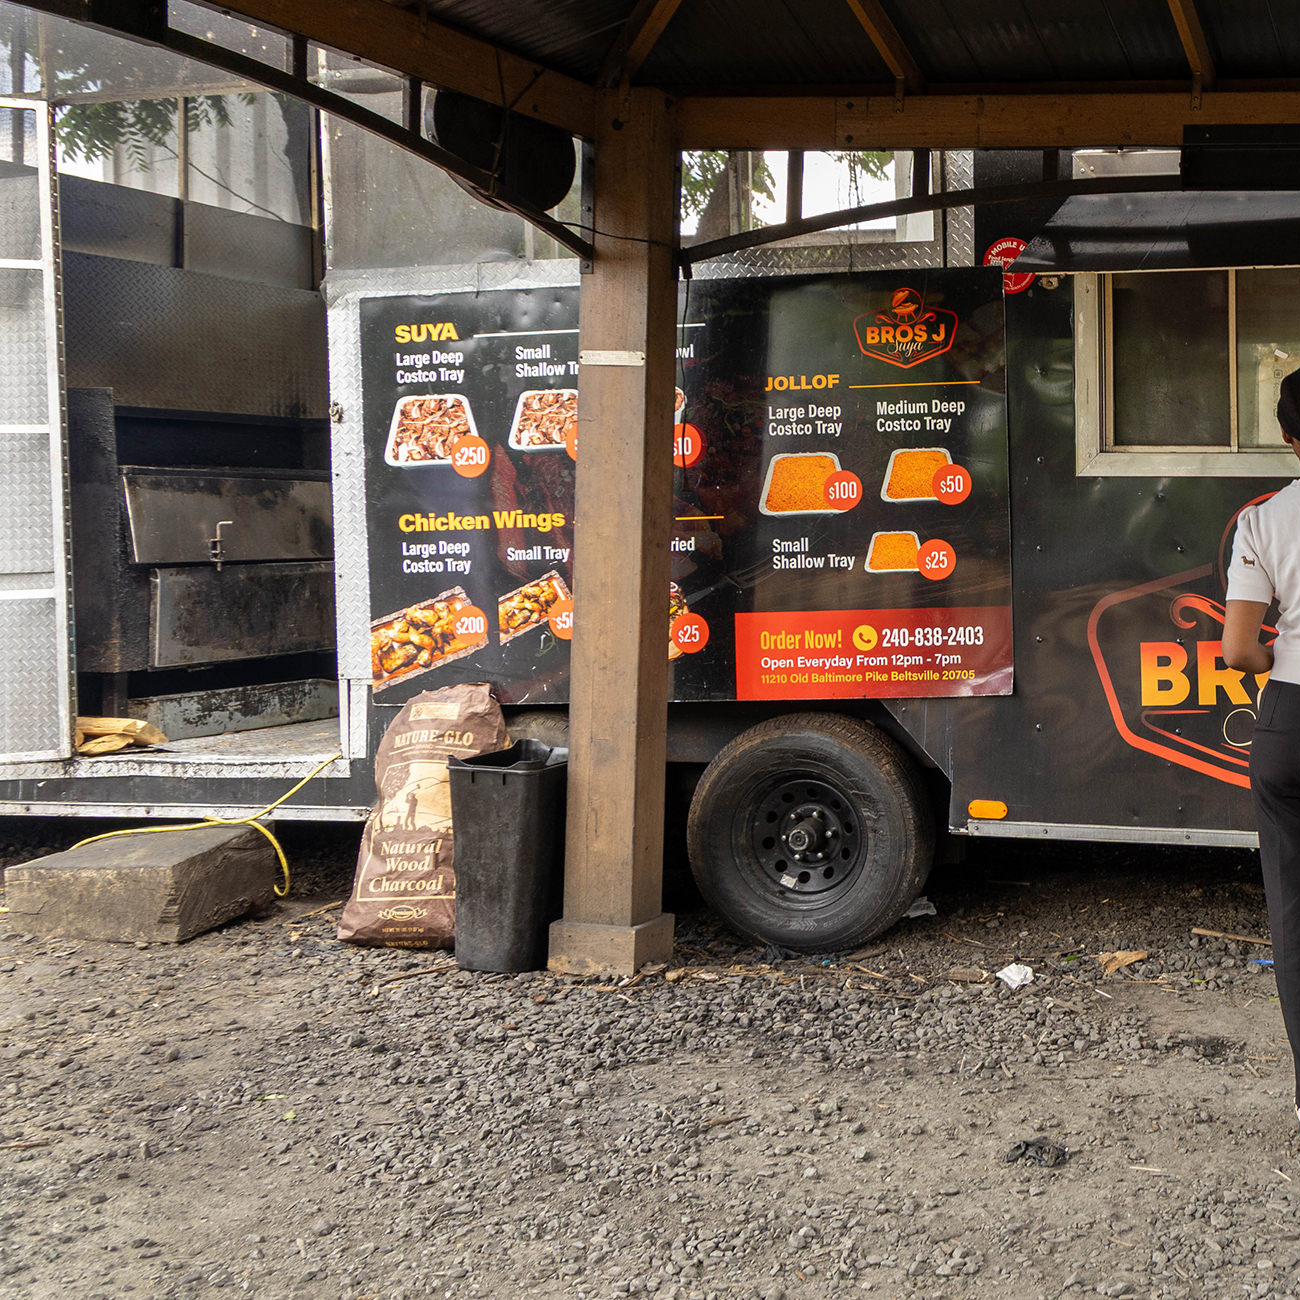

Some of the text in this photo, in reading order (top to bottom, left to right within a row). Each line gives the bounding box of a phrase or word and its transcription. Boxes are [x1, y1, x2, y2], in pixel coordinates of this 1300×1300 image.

[991, 241, 1017, 256] MOBILE
[395, 322, 459, 344] SUYA
[866, 323, 946, 344] BROS J
[515, 344, 550, 361] Small
[887, 337, 924, 357] Suya
[396, 350, 464, 369] Large Deep
[396, 368, 465, 385] Costco Tray
[515, 361, 565, 378] Shallow
[765, 374, 840, 392] JOLLOF
[768, 404, 842, 422] Large Deep
[876, 400, 966, 416] Medium Deep
[768, 420, 843, 438] Costco Tray
[876, 416, 952, 433] Costco Tray
[455, 446, 486, 467] $250
[828, 481, 857, 500] $100
[940, 475, 964, 494] $50
[399, 510, 565, 532] Chicken Wings
[402, 541, 470, 559] Large Deep
[670, 537, 695, 552] ried
[772, 538, 809, 553] Small
[507, 546, 570, 562] Small Tray
[772, 554, 856, 571] Shallow Tray
[925, 551, 948, 569] $25
[403, 558, 471, 575] Costco Tray
[456, 616, 485, 635] $200
[677, 624, 700, 644] $25
[760, 626, 984, 650] Order Now! 240-838-2403
[761, 656, 794, 670] Open
[797, 655, 854, 670] Everyday
[856, 654, 888, 667] From
[890, 654, 924, 669] 12pm
[934, 653, 962, 668] 7pm
[761, 669, 976, 685] 11210 Old Baltimore Pike Beltsville 20705
[394, 729, 474, 748] NATURE-GLO
[380, 839, 443, 856] Natural
[386, 857, 430, 873] Wood
[369, 875, 444, 893] Charcoal
